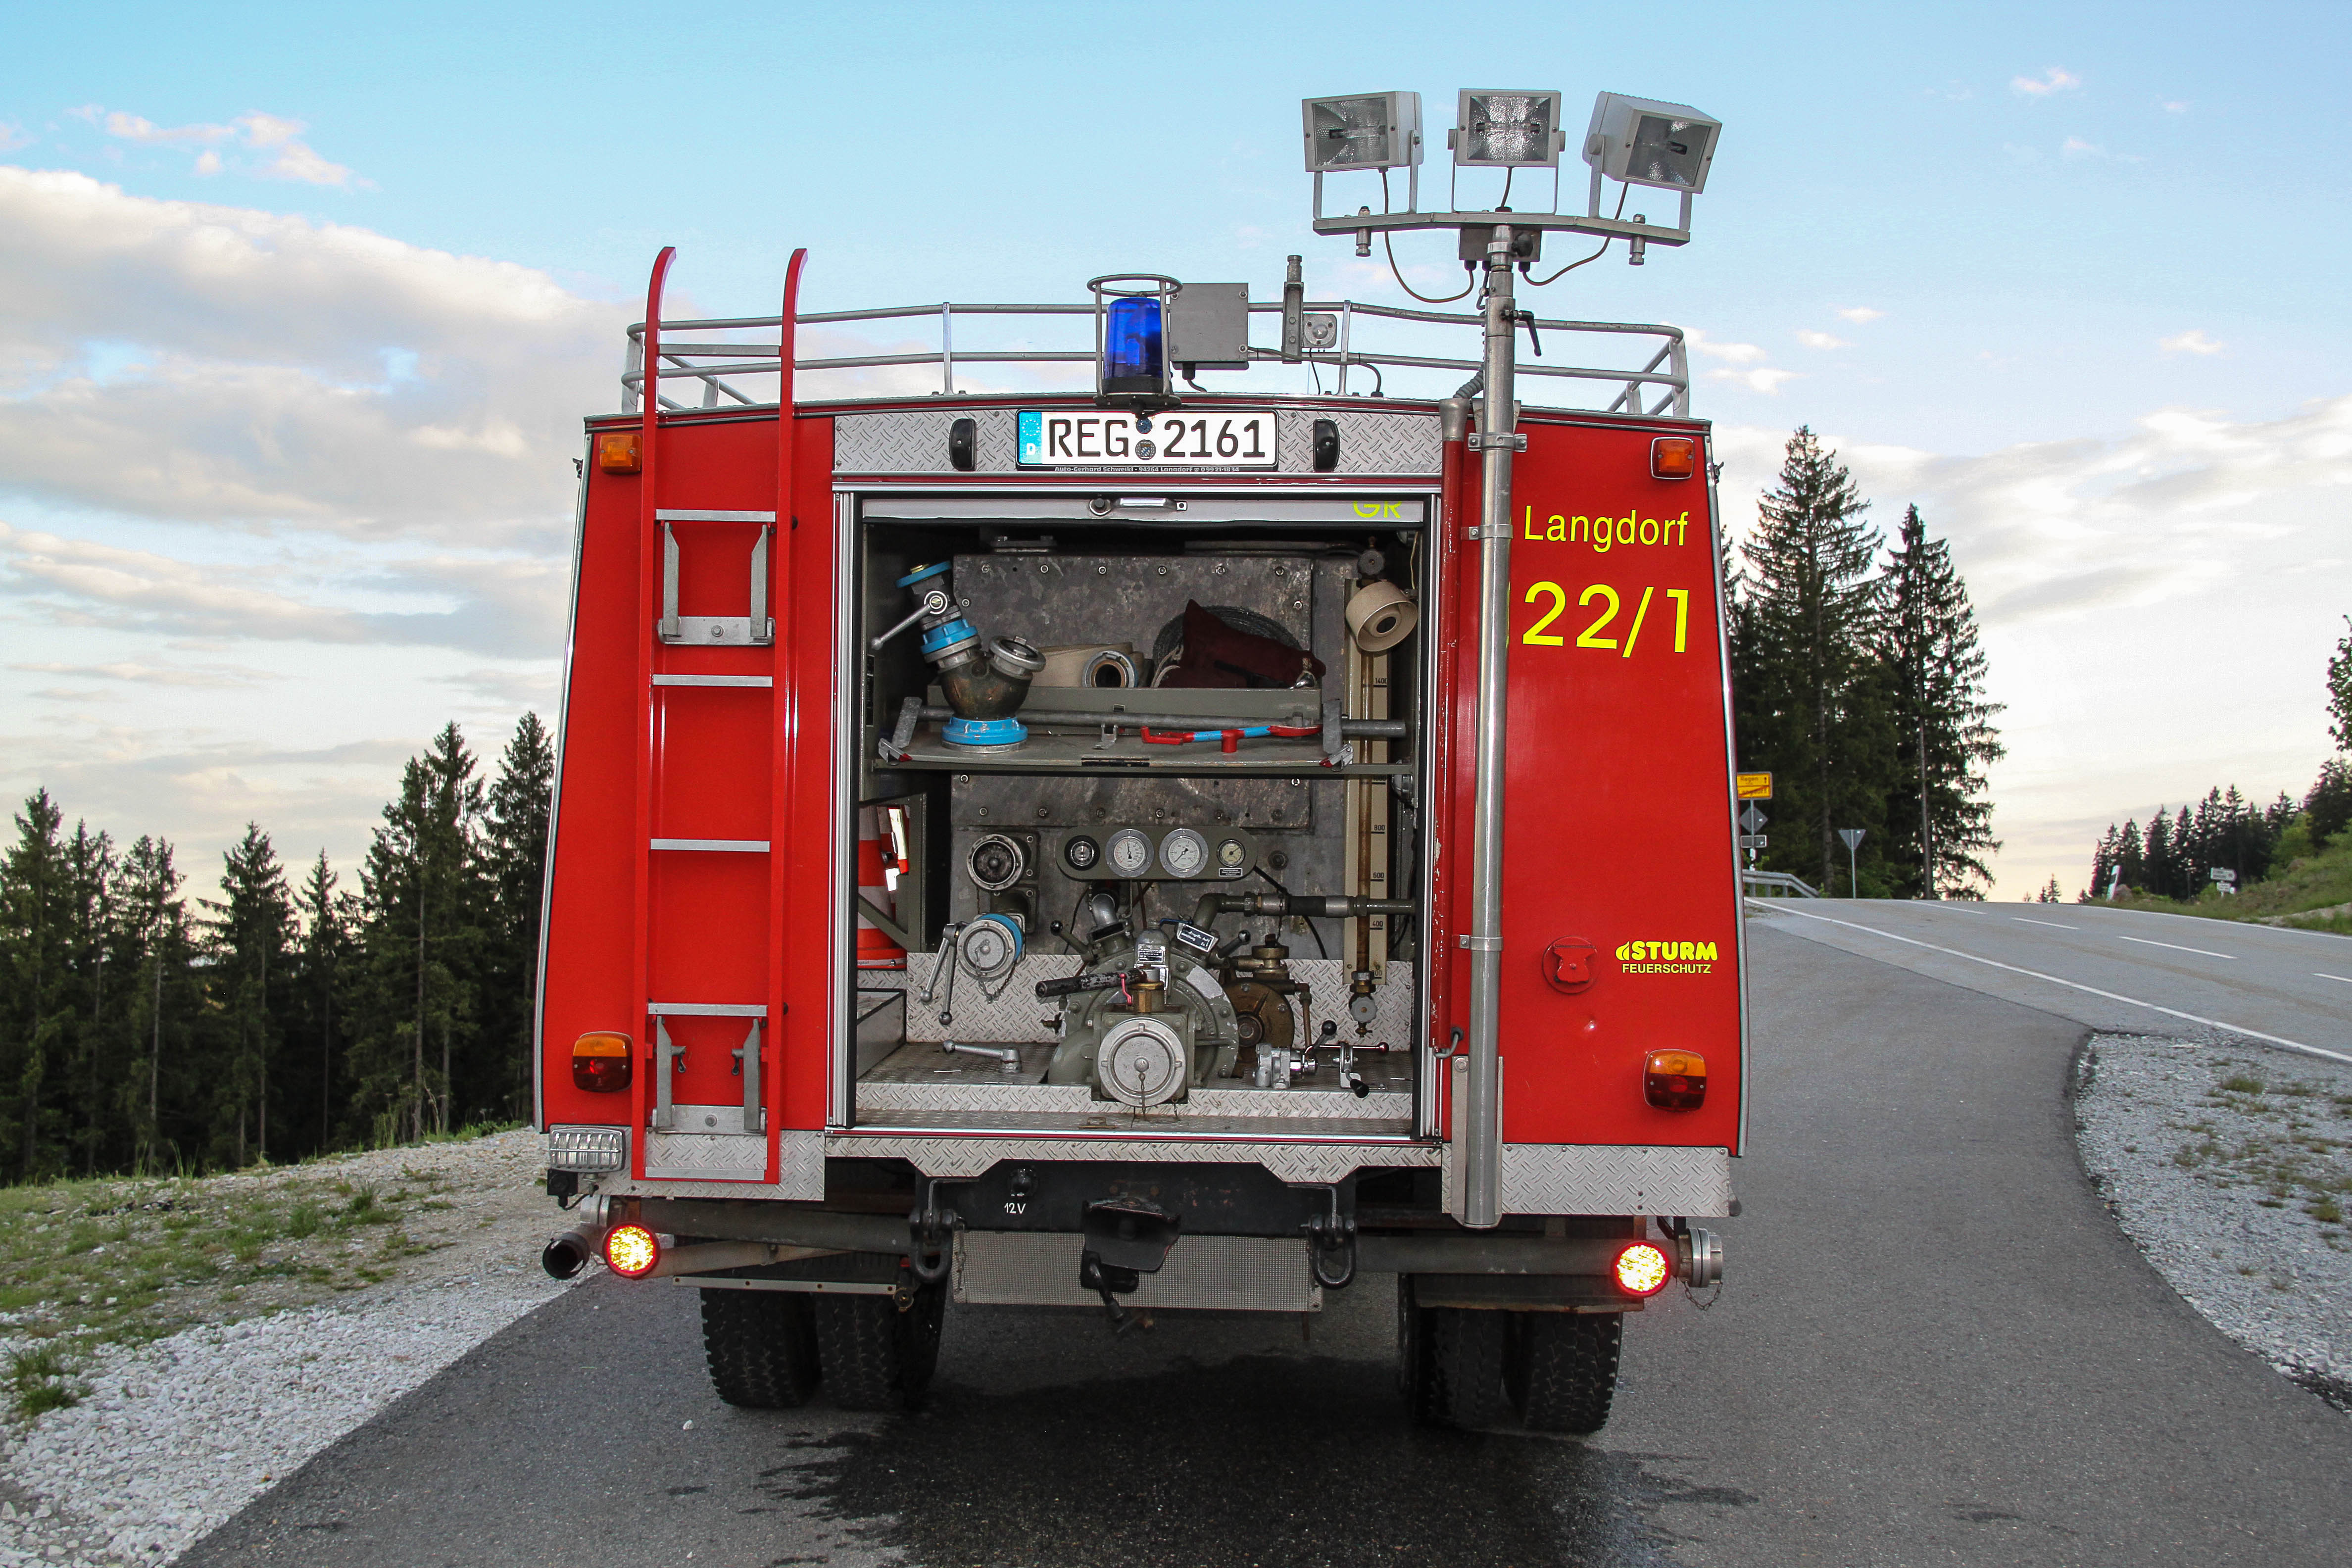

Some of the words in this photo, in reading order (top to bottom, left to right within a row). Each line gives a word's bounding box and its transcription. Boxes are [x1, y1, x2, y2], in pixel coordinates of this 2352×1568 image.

[1049, 419, 1129, 457] REG
[1163, 419, 1265, 458] 2161
[1026, 443, 1036, 455] D
[1524, 505, 1689, 553] Langdorf
[1522, 581, 1689, 658] 22/1
[1630, 941, 1718, 961] STURM
[1621, 963, 1712, 974] FEUERSCHUTZ
[1004, 1202, 1027, 1214] 12V
